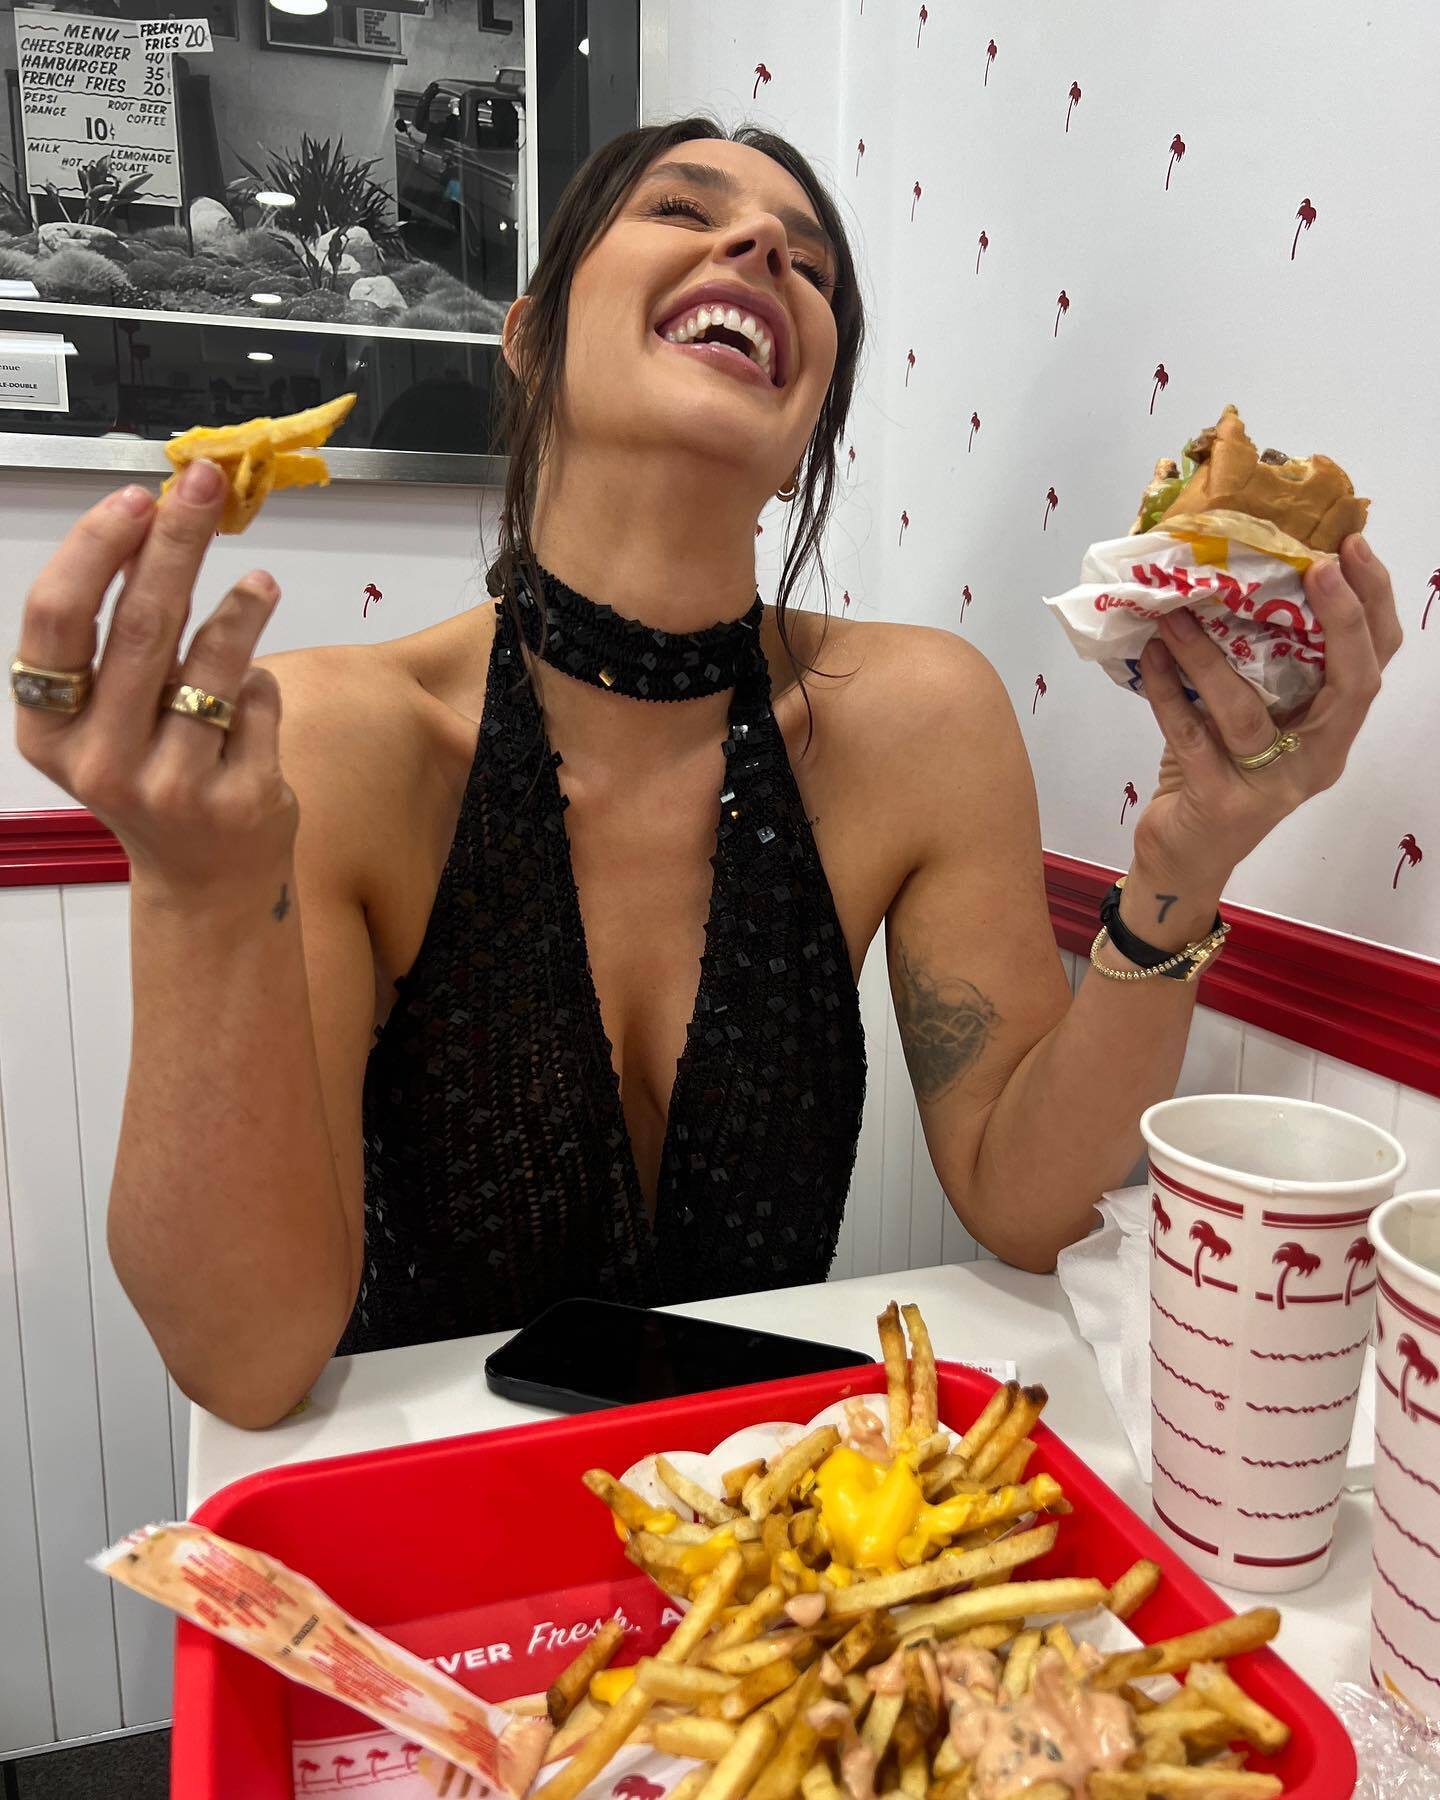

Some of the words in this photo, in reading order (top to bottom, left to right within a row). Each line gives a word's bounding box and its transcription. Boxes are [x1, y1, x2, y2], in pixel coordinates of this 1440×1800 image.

[64, 24, 120, 42] MENU
[140, 23, 183, 38] FRENCH
[145, 37, 179, 50] FRIES
[21, 38, 131, 60] CHEESEBURGER
[145, 53, 165, 65] 40
[21, 54, 118, 76] HAMBURGER
[145, 67, 165, 80] 35
[22, 70, 75, 87] FRENCH
[85, 76, 126, 93] FRIES
[143, 81, 165, 96] 20
[24, 91, 58, 104] PEPSI
[24, 105, 67, 117] ORANGE
[108, 100, 135, 111] ROOT
[139, 103, 167, 115] BEER
[126, 114, 167, 126] COFFEE
[28, 142, 61, 153] MILK
[61, 158, 84, 167] HOT
[110, 149, 172, 165] LEMONADE
[1155, 893, 1178, 923] 7
[423, 1643, 513, 1674] VER
